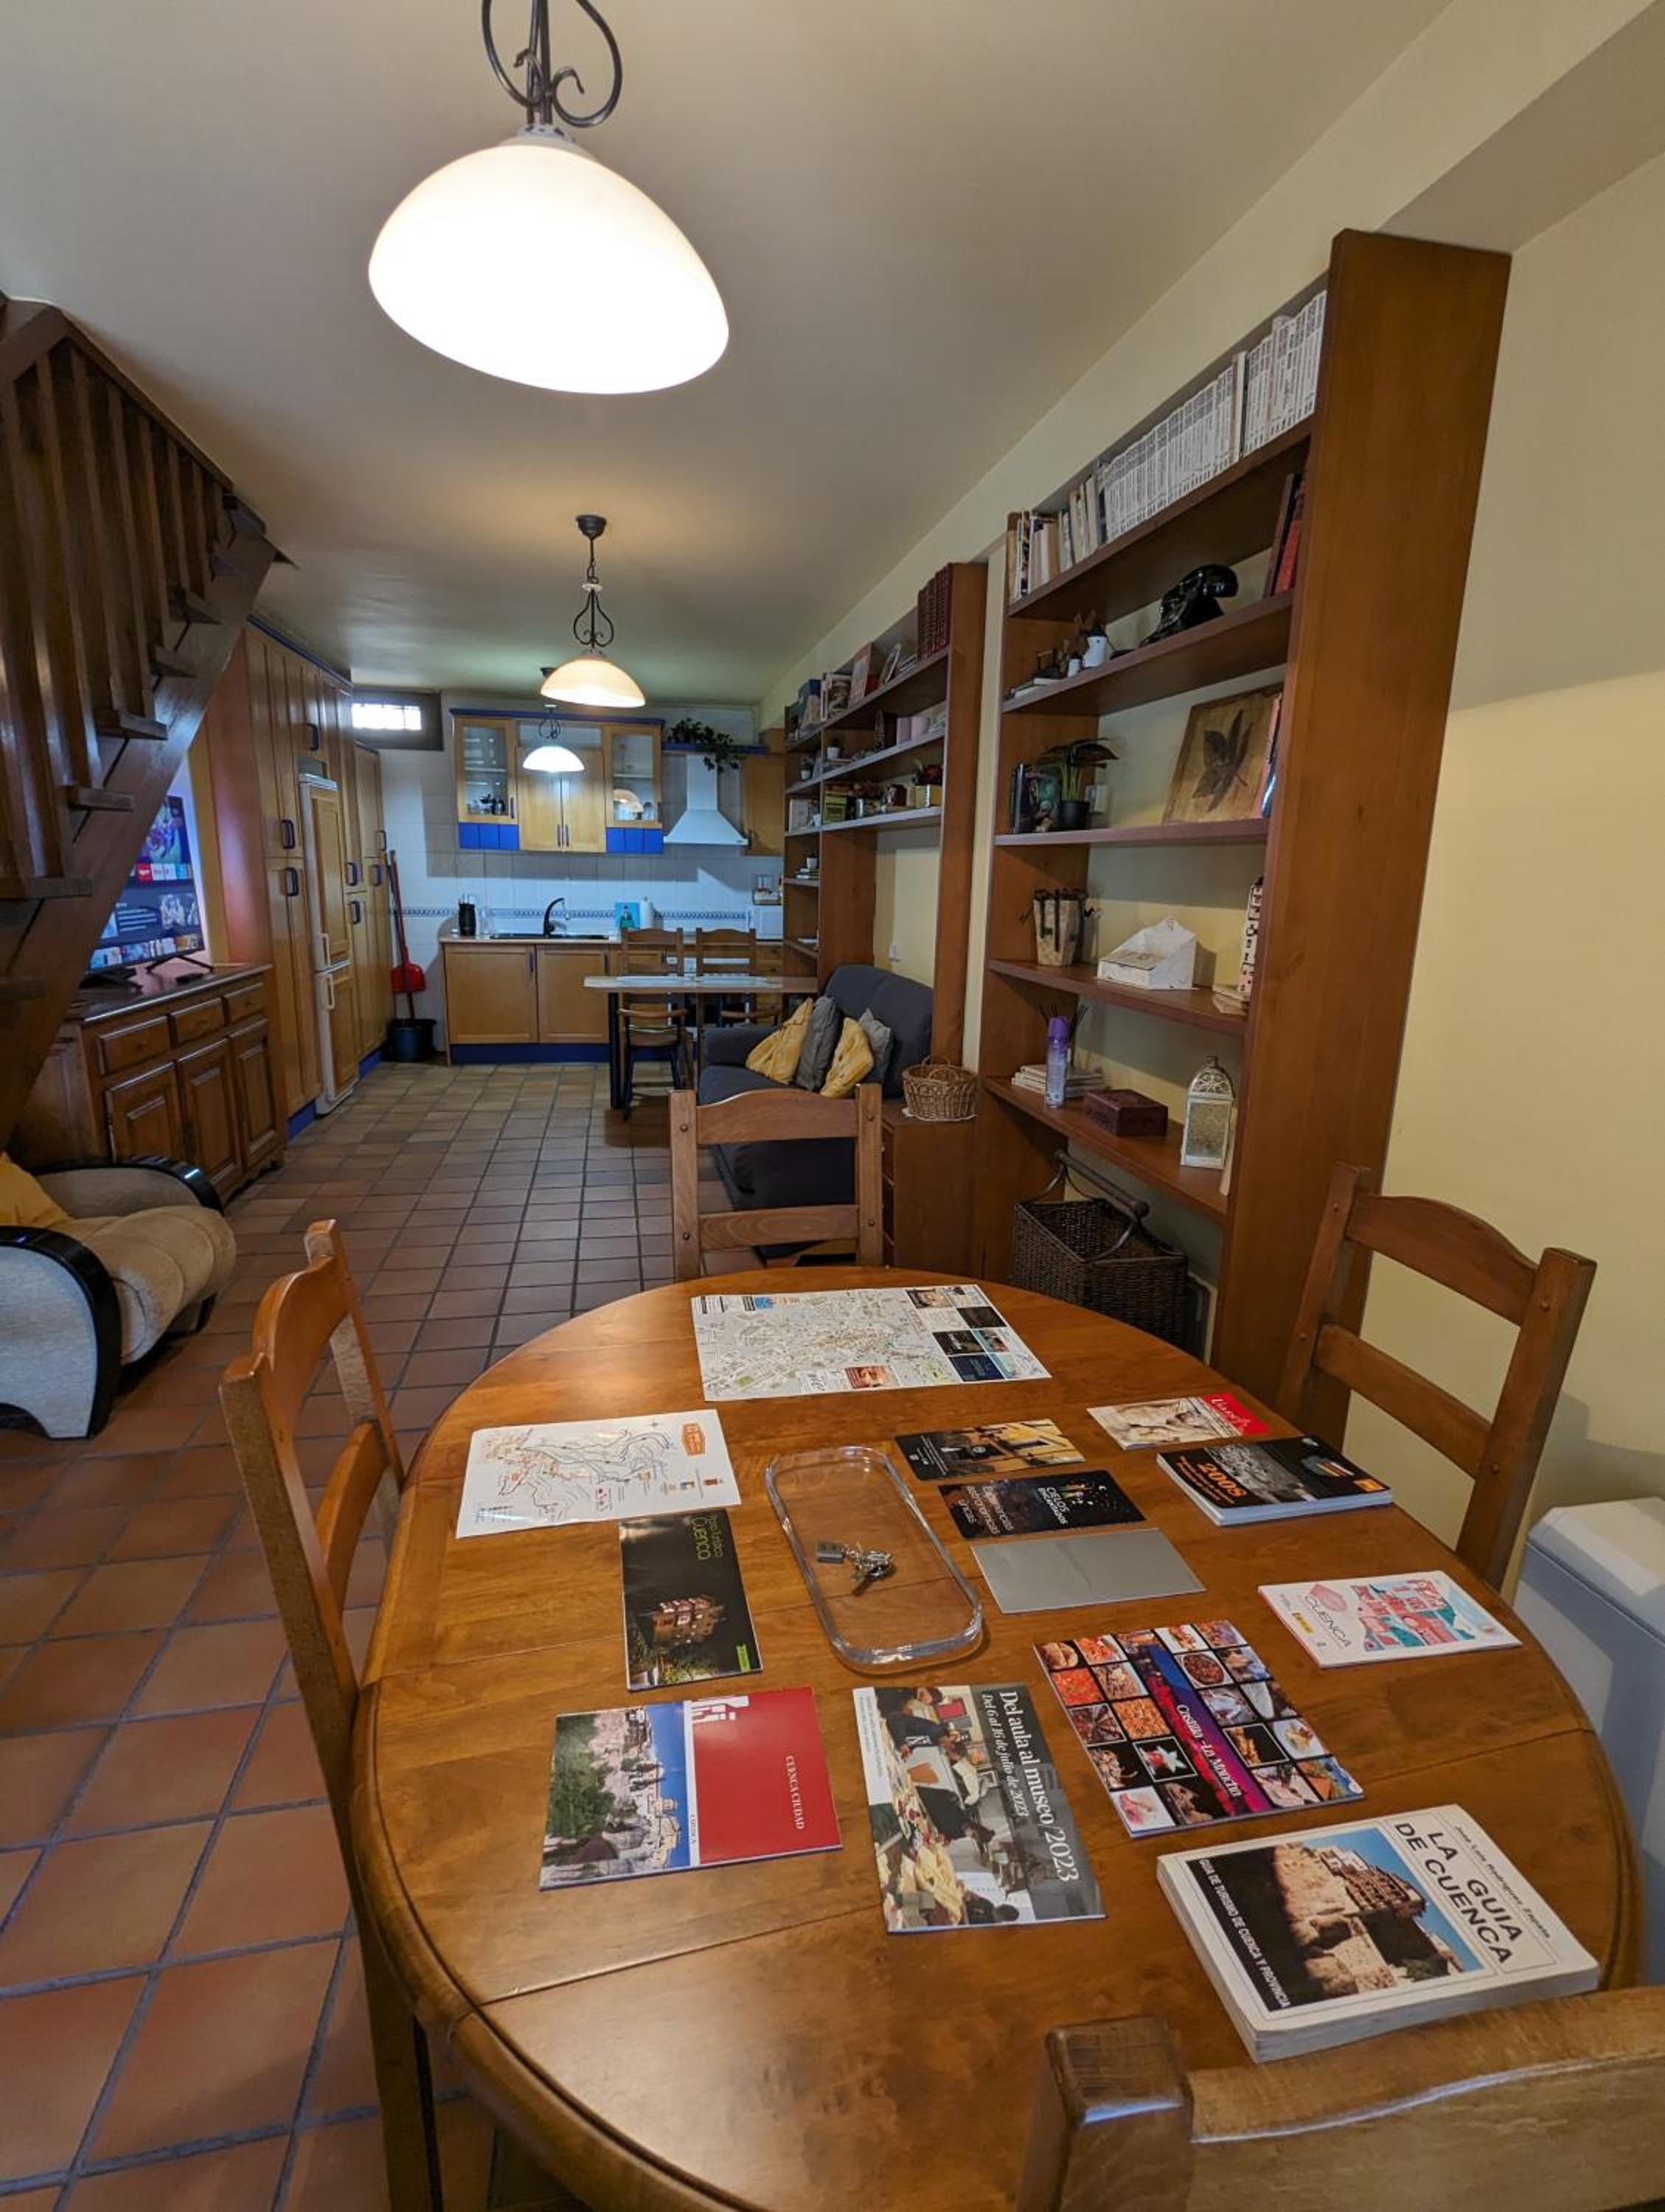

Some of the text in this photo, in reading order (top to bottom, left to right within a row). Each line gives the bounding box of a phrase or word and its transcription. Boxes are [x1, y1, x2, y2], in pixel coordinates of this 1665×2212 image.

[1044, 1486, 1071, 1512] CIELOS
[981, 1694, 996, 1708] Del
[998, 1691, 1023, 1715] Del
[988, 1717, 1001, 1726] al
[1007, 1717, 1032, 1748] aula
[994, 1739, 1009, 1751] de
[1018, 1750, 1040, 1764] al
[994, 1750, 1017, 1774] julio
[784, 1754, 805, 1830] CUENCA CIUDAD
[1005, 1775, 1021, 1788] de
[1009, 1789, 1029, 1817] 2023
[1392, 1822, 1520, 1963] DE CUENCA
[1425, 1832, 1529, 1941] LA GUIA
[1196, 1858, 1295, 2008] GUIA DE TURISMO DE CUENCA Y PROVINCIA
